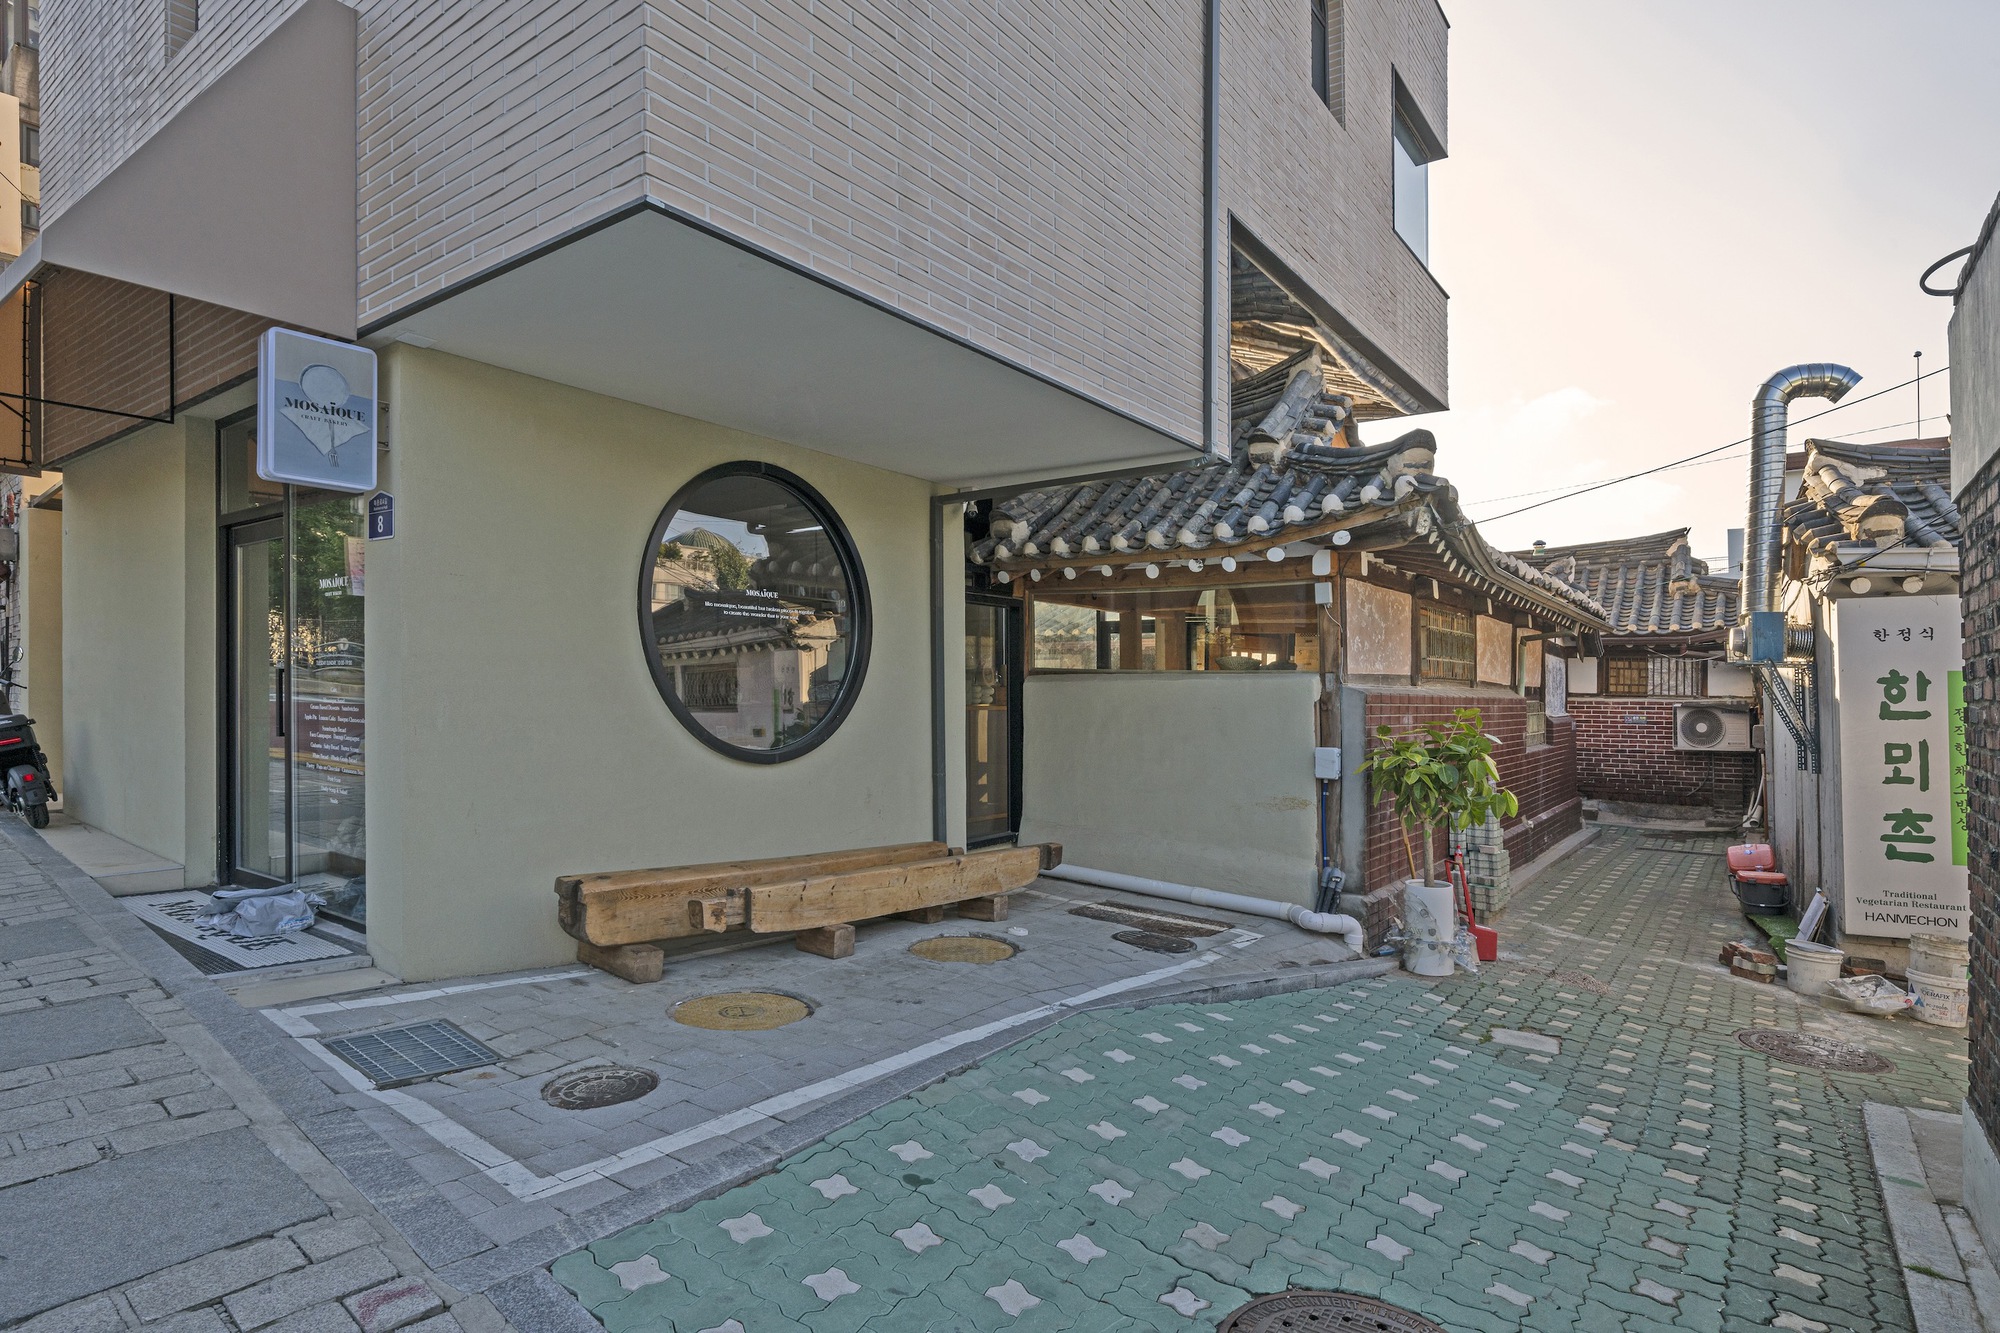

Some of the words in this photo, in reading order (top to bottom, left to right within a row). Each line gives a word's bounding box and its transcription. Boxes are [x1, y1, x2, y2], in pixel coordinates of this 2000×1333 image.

[284, 397, 366, 422] MOSAÏQUE
[301, 414, 321, 422] CRAFT
[324, 418, 348, 427] BAKERY
[377, 515, 384, 533] 8
[1873, 627, 1935, 643] 한정식
[1876, 669, 1936, 863] 한뫼촌
[1882, 889, 1938, 901] Traditional
[1855, 896, 1909, 908] Vegetarian
[1911, 900, 1967, 912] Restaurant
[1865, 911, 1958, 928] HANMECHON
[1266, 1297, 1360, 1312] GOVERNMENT
